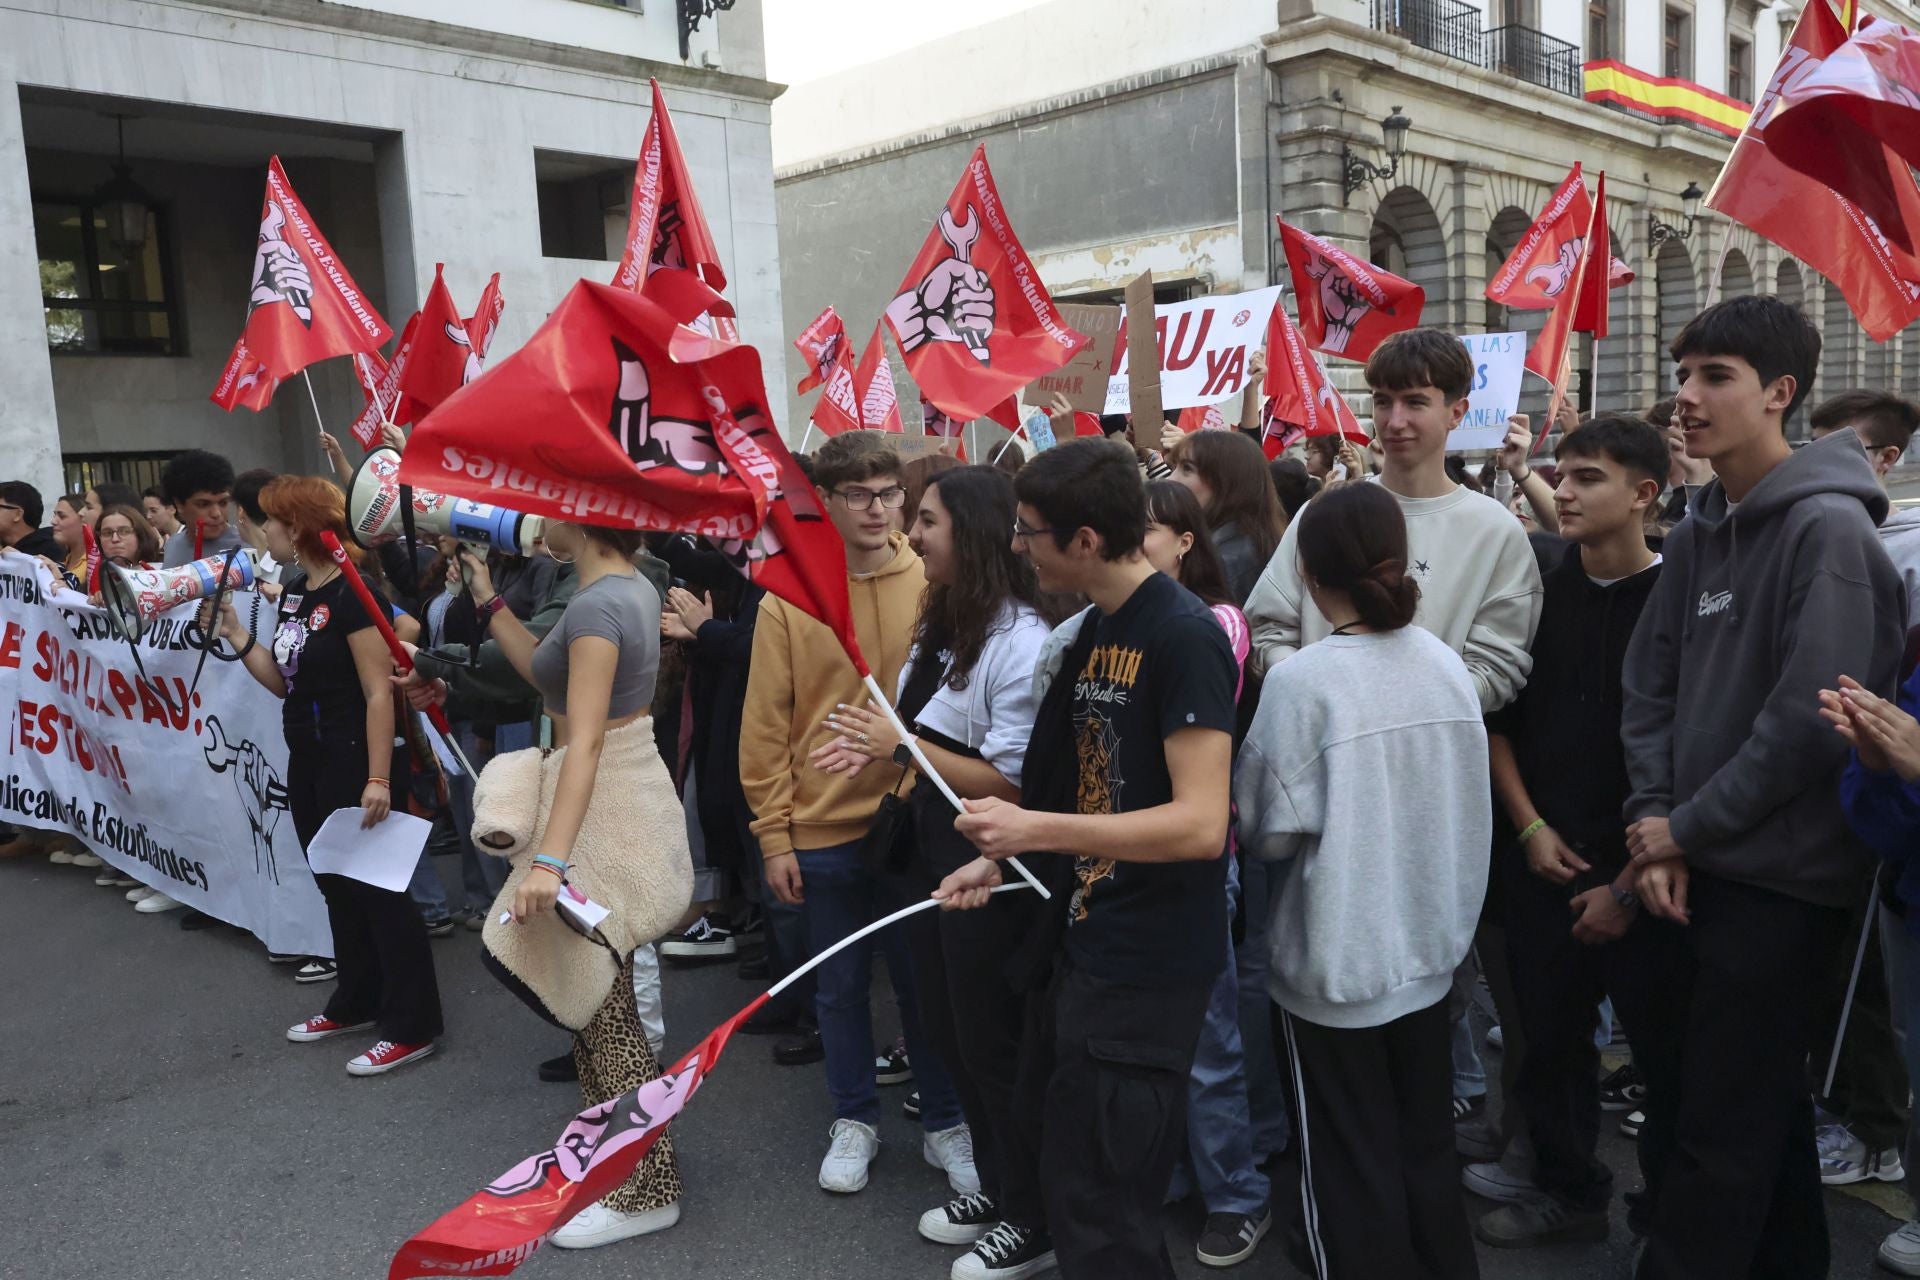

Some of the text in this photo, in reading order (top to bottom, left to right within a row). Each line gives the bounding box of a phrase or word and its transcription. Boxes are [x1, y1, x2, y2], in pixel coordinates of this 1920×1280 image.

[267, 169, 313, 239] Sindicato
[308, 235, 325, 257] de
[319, 255, 383, 338] Estudiantes
[622, 215, 652, 291] Sindicato
[638, 199, 655, 220] de
[970, 160, 1077, 349] Sindicato de Estudiantes
[1492, 174, 1584, 297] Sindicato de Estudiantes
[1343, 258, 1388, 305] Sindicato
[1198, 345, 1247, 396] YA
[1481, 335, 1514, 353] LAS
[217, 361, 243, 399] Sindicato
[1297, 381, 1318, 431] Sindicato
[358, 492, 389, 533] IZQUIERDA
[108, 668, 203, 737] PAU:
[65, 796, 88, 838] de
[91, 801, 210, 893] Estudiantes
